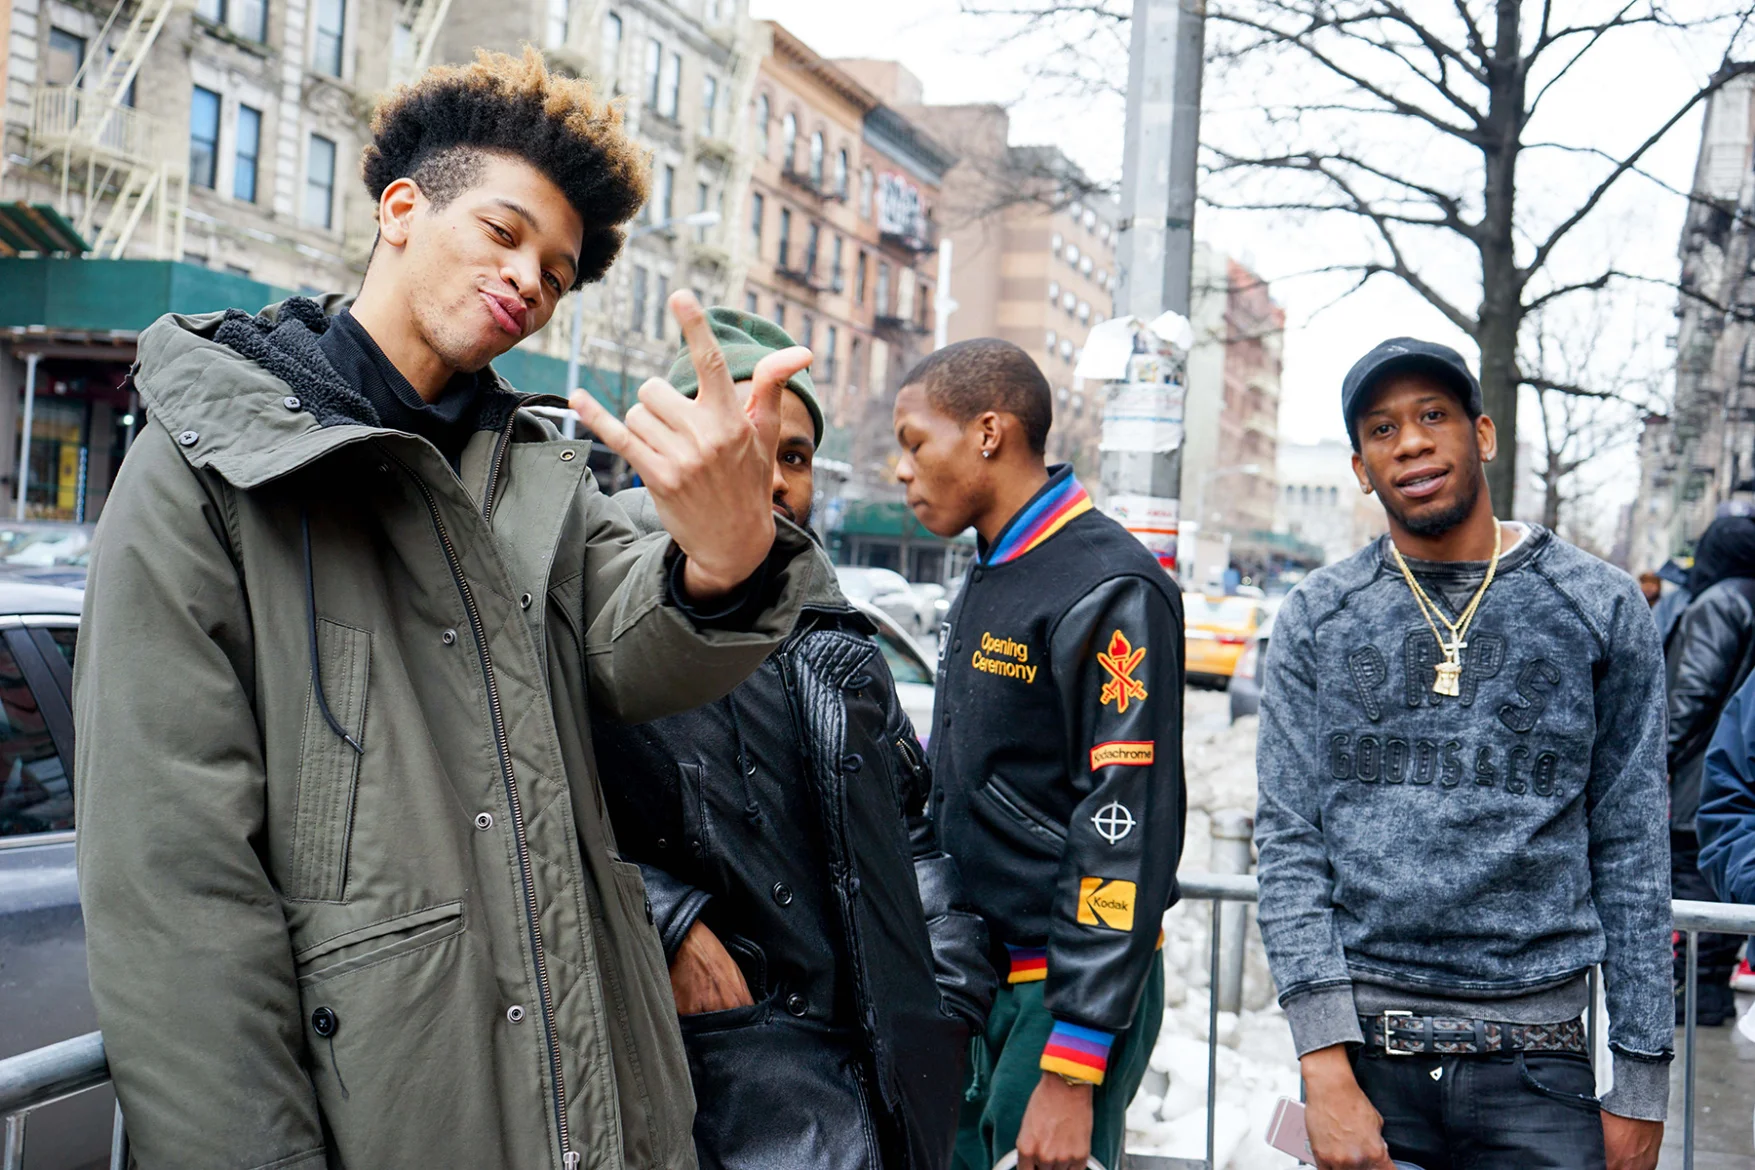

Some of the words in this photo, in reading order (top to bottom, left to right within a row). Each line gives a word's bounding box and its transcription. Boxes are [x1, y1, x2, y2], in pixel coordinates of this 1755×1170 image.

[981, 631, 1029, 662] Opening
[971, 650, 1037, 684] Ceremony
[1331, 734, 1461, 787] GOODS
[1093, 896, 1128, 911] Kodak
